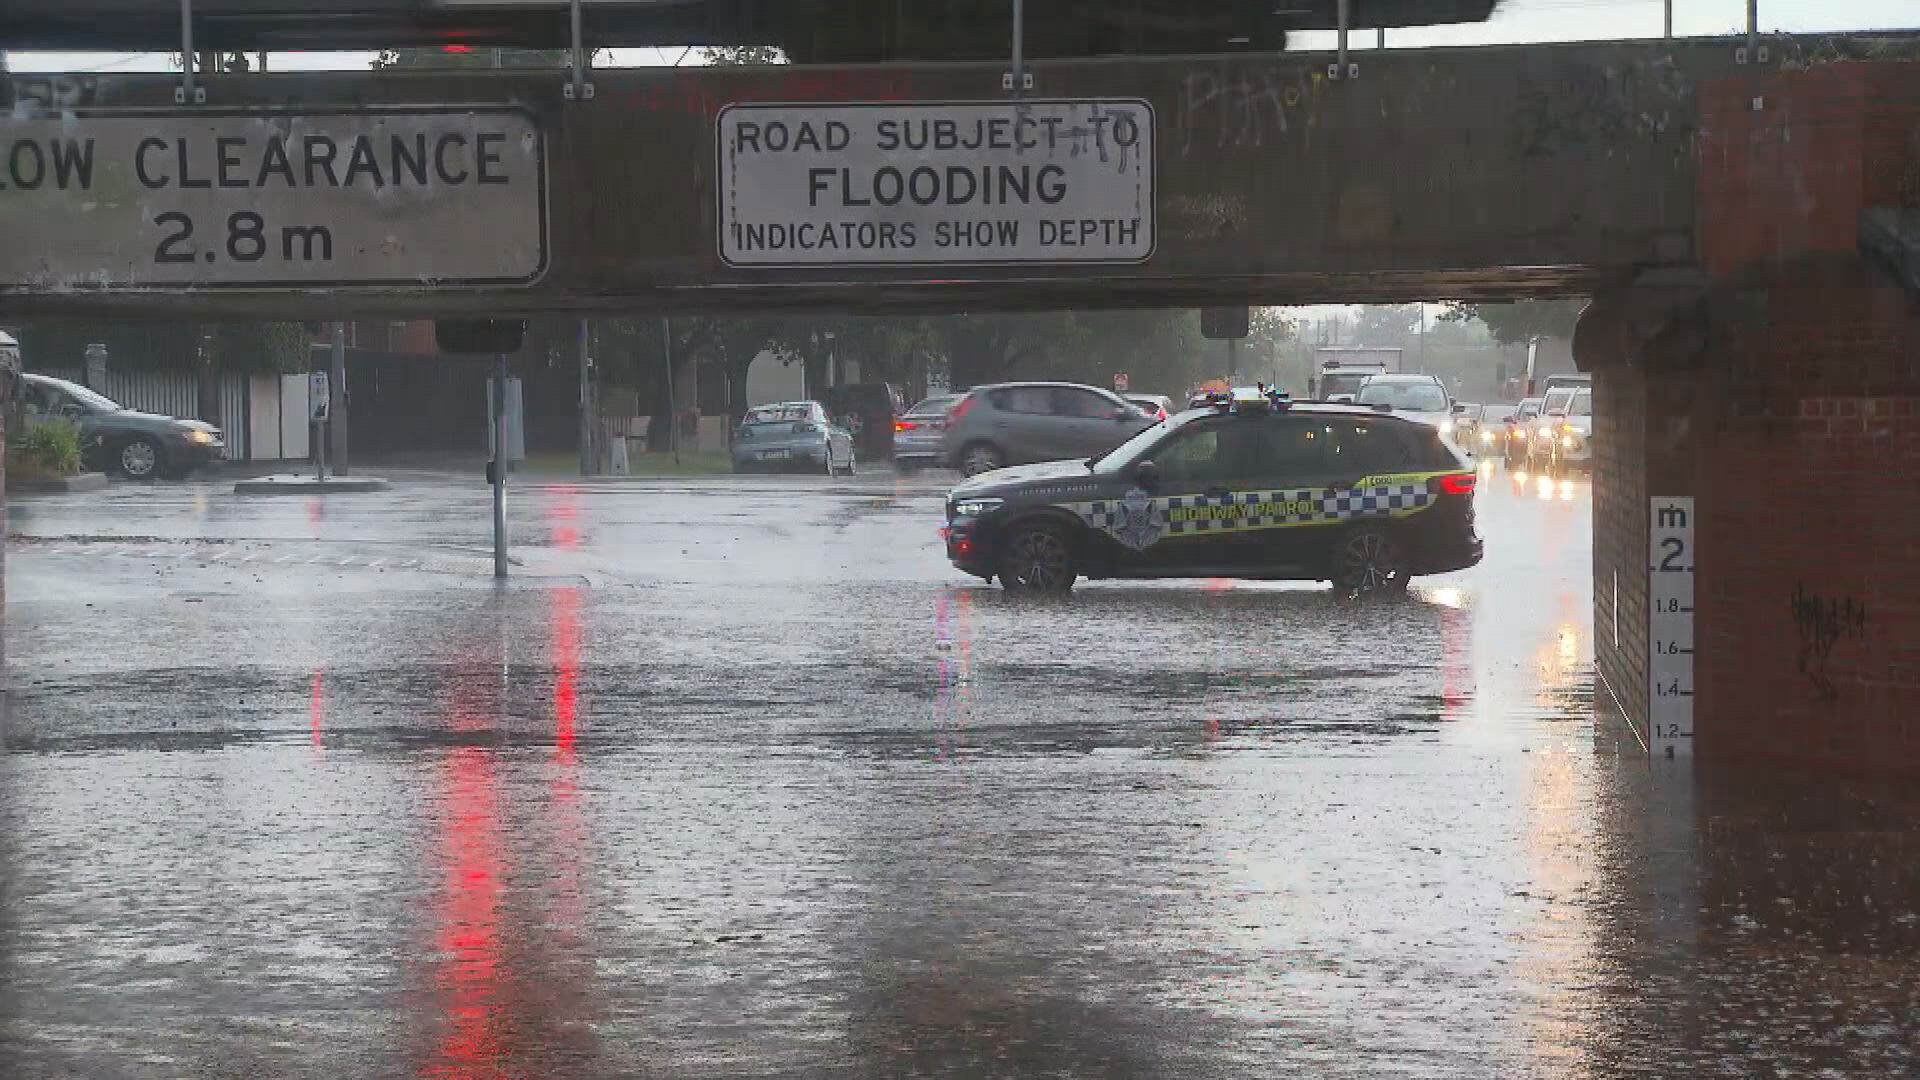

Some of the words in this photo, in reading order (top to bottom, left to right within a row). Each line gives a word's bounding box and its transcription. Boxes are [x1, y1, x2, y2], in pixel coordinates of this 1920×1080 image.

[736, 121, 850, 153] ROAD
[876, 118, 1062, 151] SUBJECT
[1089, 116, 1139, 148] TO
[0, 138, 95, 191] OW
[135, 132, 510, 190] CLEARANCE
[808, 164, 1067, 207] FLOODING
[736, 221, 916, 251] INDICATORS
[934, 219, 1019, 248] SHOW
[1039, 218, 1138, 246] DEPTH
[1169, 503, 1249, 522] HIGHWAY
[1255, 499, 1319, 517] PATROL
[1659, 537, 1684, 572] 2
[1655, 599, 1679, 613] 1.8
[1655, 640, 1679, 655] 1.6
[1655, 681, 1679, 697] 1.4
[1655, 724, 1679, 738] 1.2
